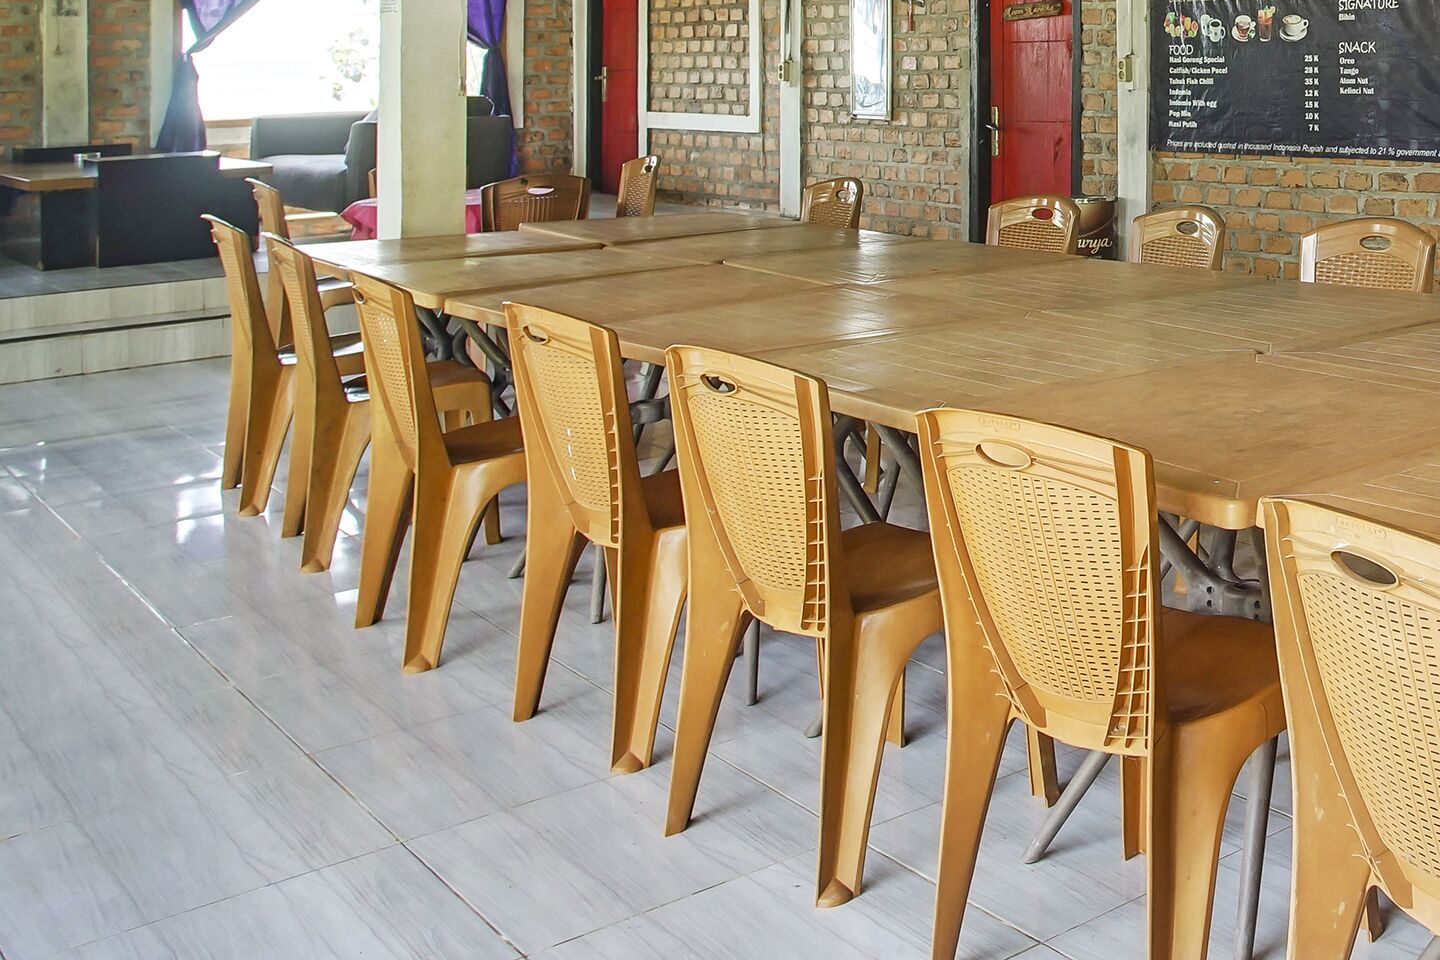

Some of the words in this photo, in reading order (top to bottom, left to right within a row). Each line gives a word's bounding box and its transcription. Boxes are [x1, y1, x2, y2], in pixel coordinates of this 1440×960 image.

[1169, 44, 1193, 55] FOOD
[1339, 42, 1376, 54] SNACK
[1340, 67, 1359, 75] Tango
[1370, 147, 1376, 155] to
[1378, 147, 1387, 155] 21
[1388, 147, 1395, 155] %
[1396, 149, 1436, 158] government
[1078, 238, 1112, 254] urya
